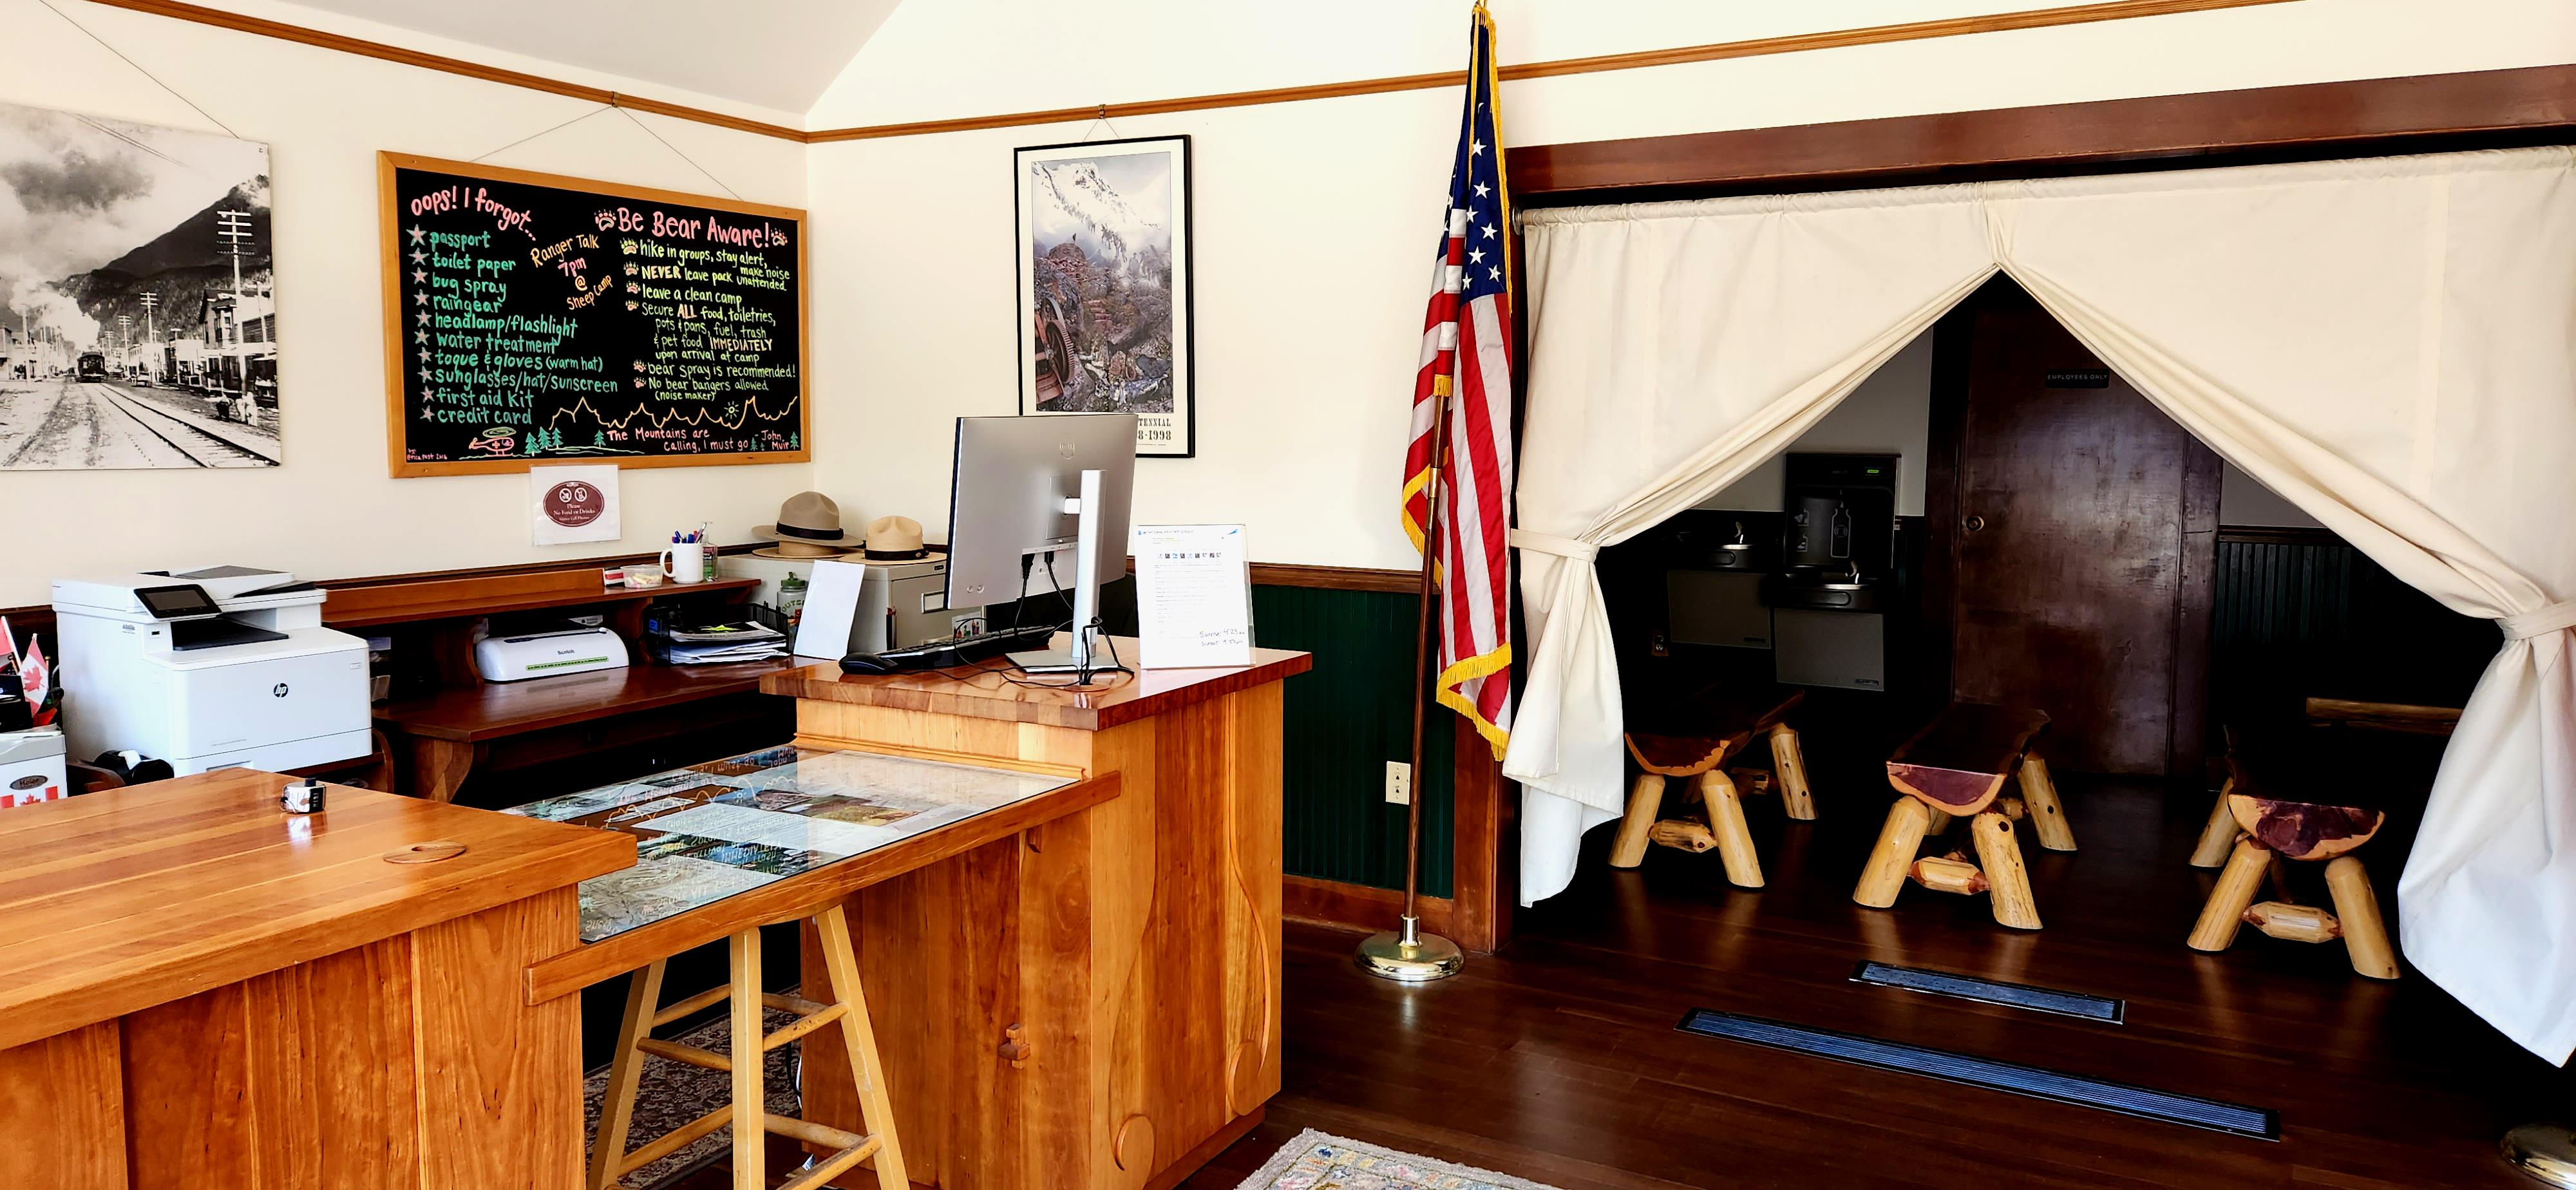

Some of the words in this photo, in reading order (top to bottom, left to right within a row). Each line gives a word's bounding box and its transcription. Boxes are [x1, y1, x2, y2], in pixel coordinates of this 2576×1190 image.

[464, 187, 469, 208] I
[618, 207, 643, 232] Be
[652, 211, 701, 239] Bear
[707, 216, 770, 248] Aware!
[429, 231, 491, 252] passport
[530, 238, 573, 268] Ranger
[576, 234, 600, 249] Talk
[640, 239, 665, 258] hike
[667, 243, 676, 258] in
[677, 249, 714, 267] groups,
[716, 249, 737, 268] stay
[740, 252, 767, 269] alert,
[432, 252, 473, 270] toilet
[477, 259, 516, 278] paper
[558, 258, 587, 277] 7pm
[740, 267, 764, 278] make
[766, 266, 790, 280] noise
[432, 272, 459, 299] bug
[464, 279, 507, 303] spray
[575, 276, 587, 291] @
[641, 265, 681, 280] NEVER
[685, 267, 708, 281] leave
[712, 272, 734, 286] pack
[737, 276, 787, 291] unattended
[567, 292, 595, 310] Sheep
[594, 275, 613, 296] Camp
[643, 283, 670, 299] leave
[674, 290, 681, 301] a
[685, 287, 712, 302] clean
[715, 292, 742, 312] camp
[433, 295, 502, 316] raingear
[677, 304, 697, 319] ALL
[701, 306, 727, 321] food,
[435, 312, 578, 346] headlamp/flashlight
[656, 317, 675, 333] pots
[684, 323, 710, 337] pans,
[714, 321, 737, 339] fuel,
[741, 325, 766, 338] trash
[436, 330, 481, 349] water
[485, 332, 556, 354] treatment
[661, 333, 677, 350] pet
[681, 334, 703, 348] food
[710, 336, 773, 352] IMMEDIATELY
[435, 349, 478, 373] toque
[494, 353, 543, 375] gloves
[545, 355, 578, 370] (warm
[581, 356, 603, 372] hat)
[656, 350, 677, 364] upon
[681, 348, 715, 361] arrival
[721, 350, 731, 363] at
[734, 353, 760, 367] camp
[648, 362, 675, 376] bear
[713, 363, 723, 377] is
[726, 364, 796, 377] recommended!
[649, 377, 661, 390] No
[665, 378, 688, 390] bear
[692, 378, 731, 394] bangers
[734, 379, 769, 391] allowed
[655, 390, 683, 401] (noise
[436, 387, 475, 407] first
[480, 389, 502, 406] aid
[437, 406, 489, 424] credit
[494, 408, 532, 424] card
[607, 430, 628, 441] The
[635, 426, 687, 441] Mountains
[692, 429, 710, 439] are
[710, 438, 734, 449] must
[737, 440, 748, 453] go
[772, 439, 790, 450] Muir
[274, 683, 288, 697] hp
